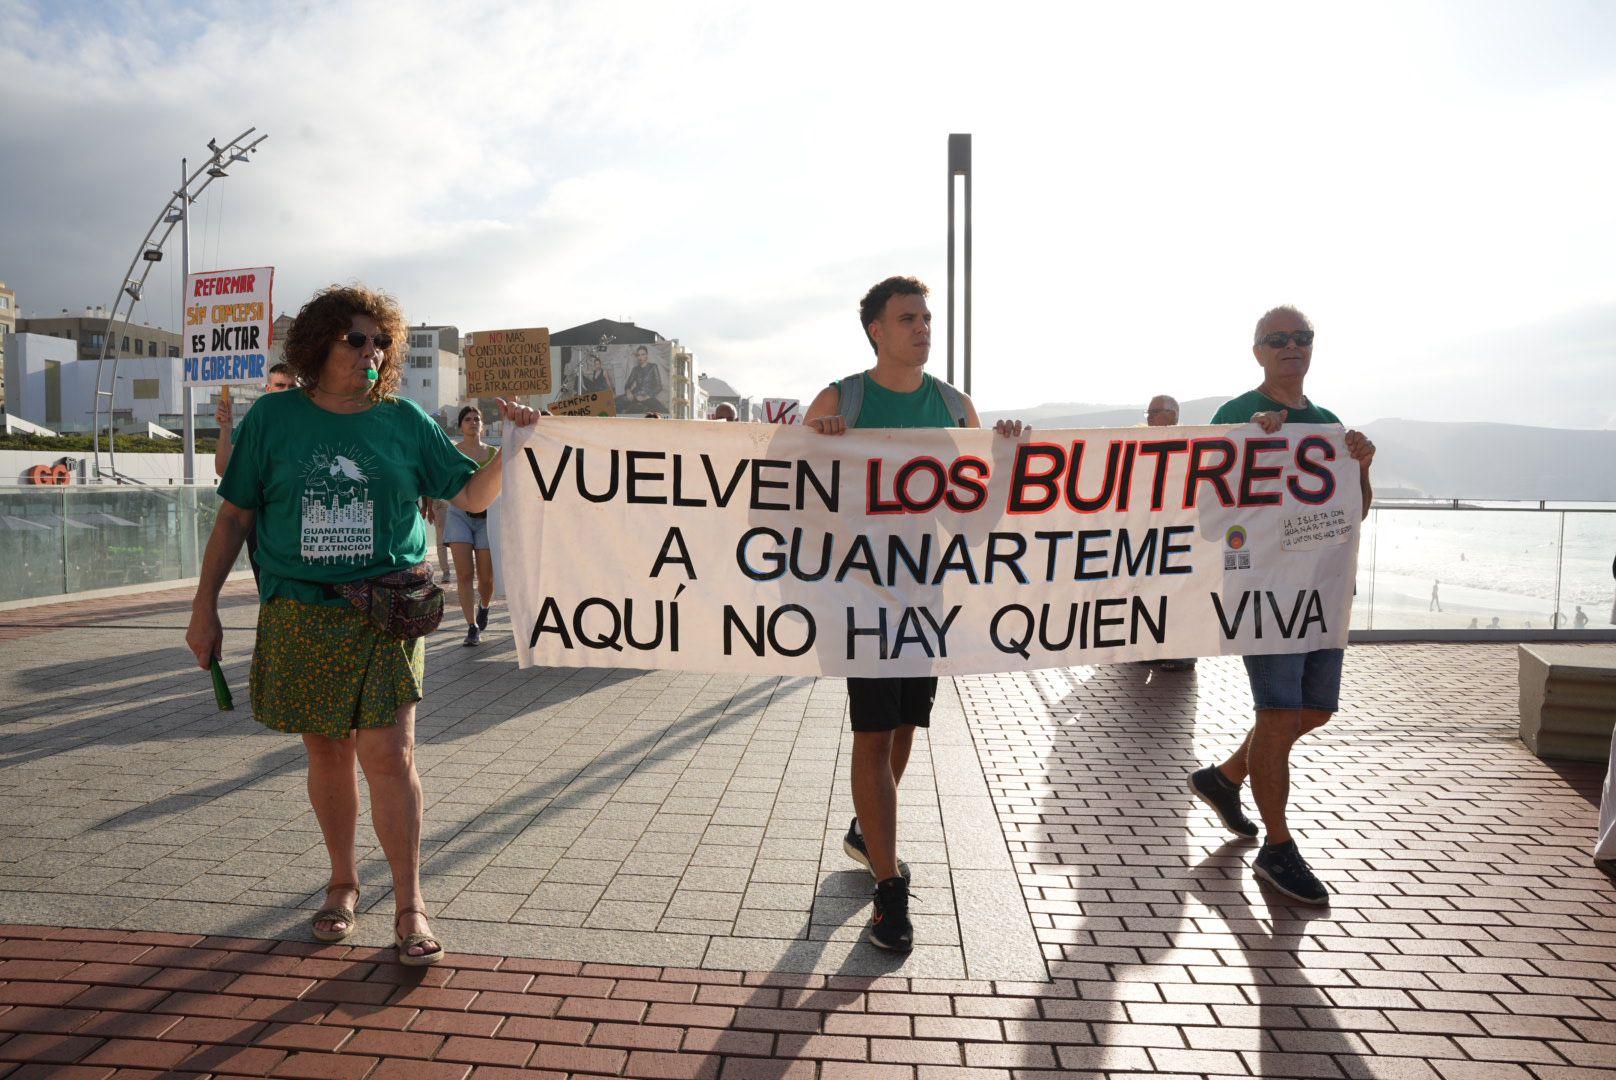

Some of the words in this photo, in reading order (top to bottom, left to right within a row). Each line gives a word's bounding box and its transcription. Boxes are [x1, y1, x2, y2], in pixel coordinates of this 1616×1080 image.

[194, 274, 256, 297] REFORMAR
[192, 335, 206, 353] ES
[212, 324, 260, 352] DICTAR
[489, 333, 503, 344] NO
[469, 342, 548, 357] CONSTRUCCIONES
[184, 357, 199, 382] NO
[201, 354, 265, 381] GOBERNAR
[476, 354, 544, 369] GUANARTEME
[468, 371, 481, 381] NO
[484, 370, 495, 381] ES
[499, 369, 510, 380] UN
[513, 367, 547, 379] PARQUE
[469, 382, 482, 393] DE
[484, 380, 549, 393] ATRACCIONES
[558, 393, 598, 409] CEMENTO
[524, 445, 840, 512] VUELVEN
[866, 456, 990, 515] LOS
[1006, 434, 1336, 515] BUITRES
[303, 527, 371, 535] GUANARTEME
[303, 535, 318, 543] EN
[322, 535, 371, 543] PELIGRO
[303, 544, 315, 552] DE
[318, 542, 372, 552] EXTINCIÓN
[649, 526, 697, 580] A
[736, 525, 1194, 587] GUANARTEME
[529, 584, 680, 652] AQUÍ
[723, 603, 817, 658] NO
[846, 605, 962, 660] HAY
[989, 596, 1168, 660] QUIEN
[1210, 589, 1328, 640] VIVA
